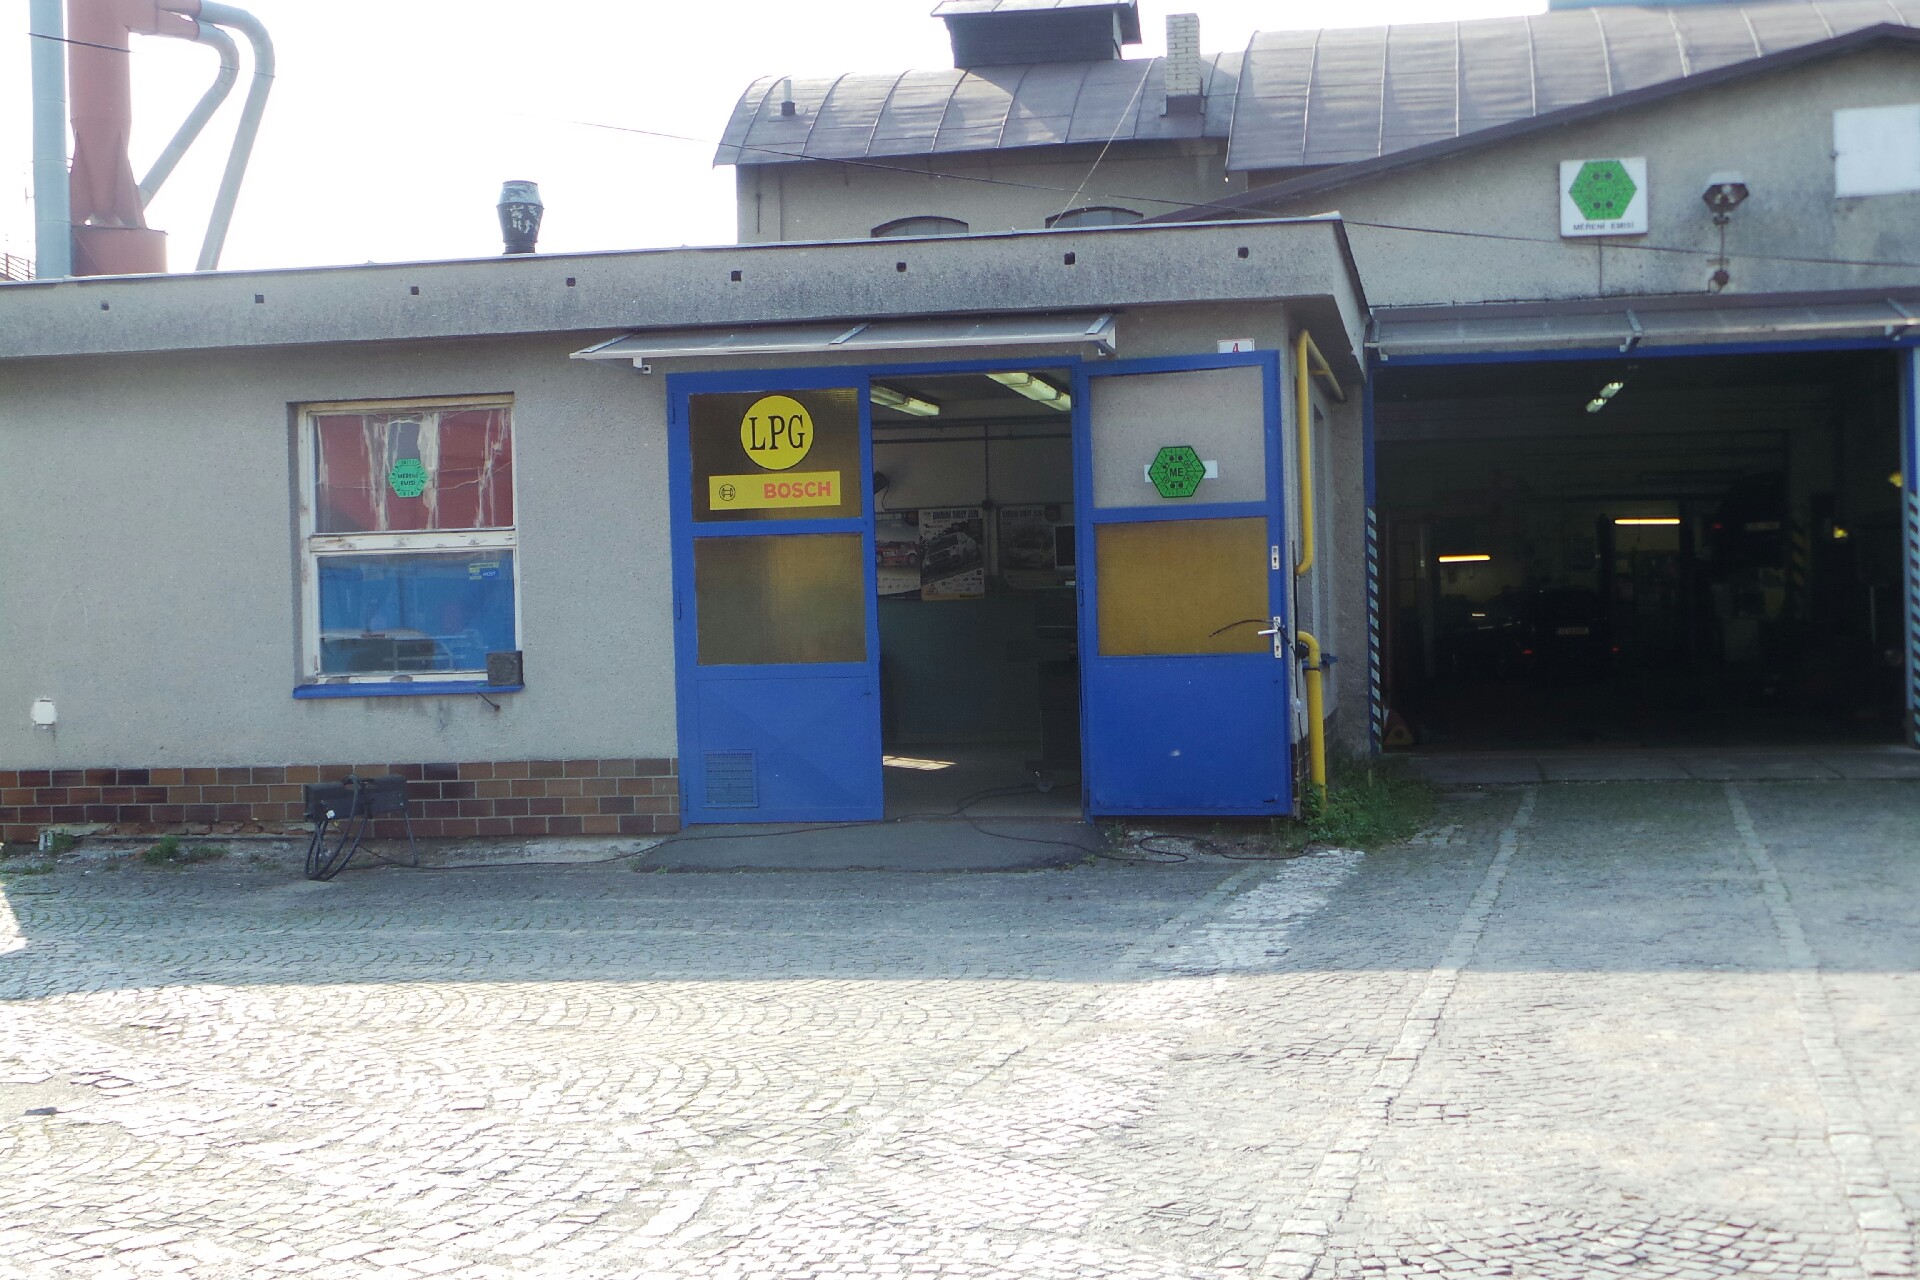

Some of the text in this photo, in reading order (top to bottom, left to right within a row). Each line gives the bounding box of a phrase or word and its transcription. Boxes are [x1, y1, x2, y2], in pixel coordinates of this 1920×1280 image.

[749, 414, 805, 450] LPG
[1169, 467, 1184, 477] ME
[763, 481, 832, 499] BOSCH
